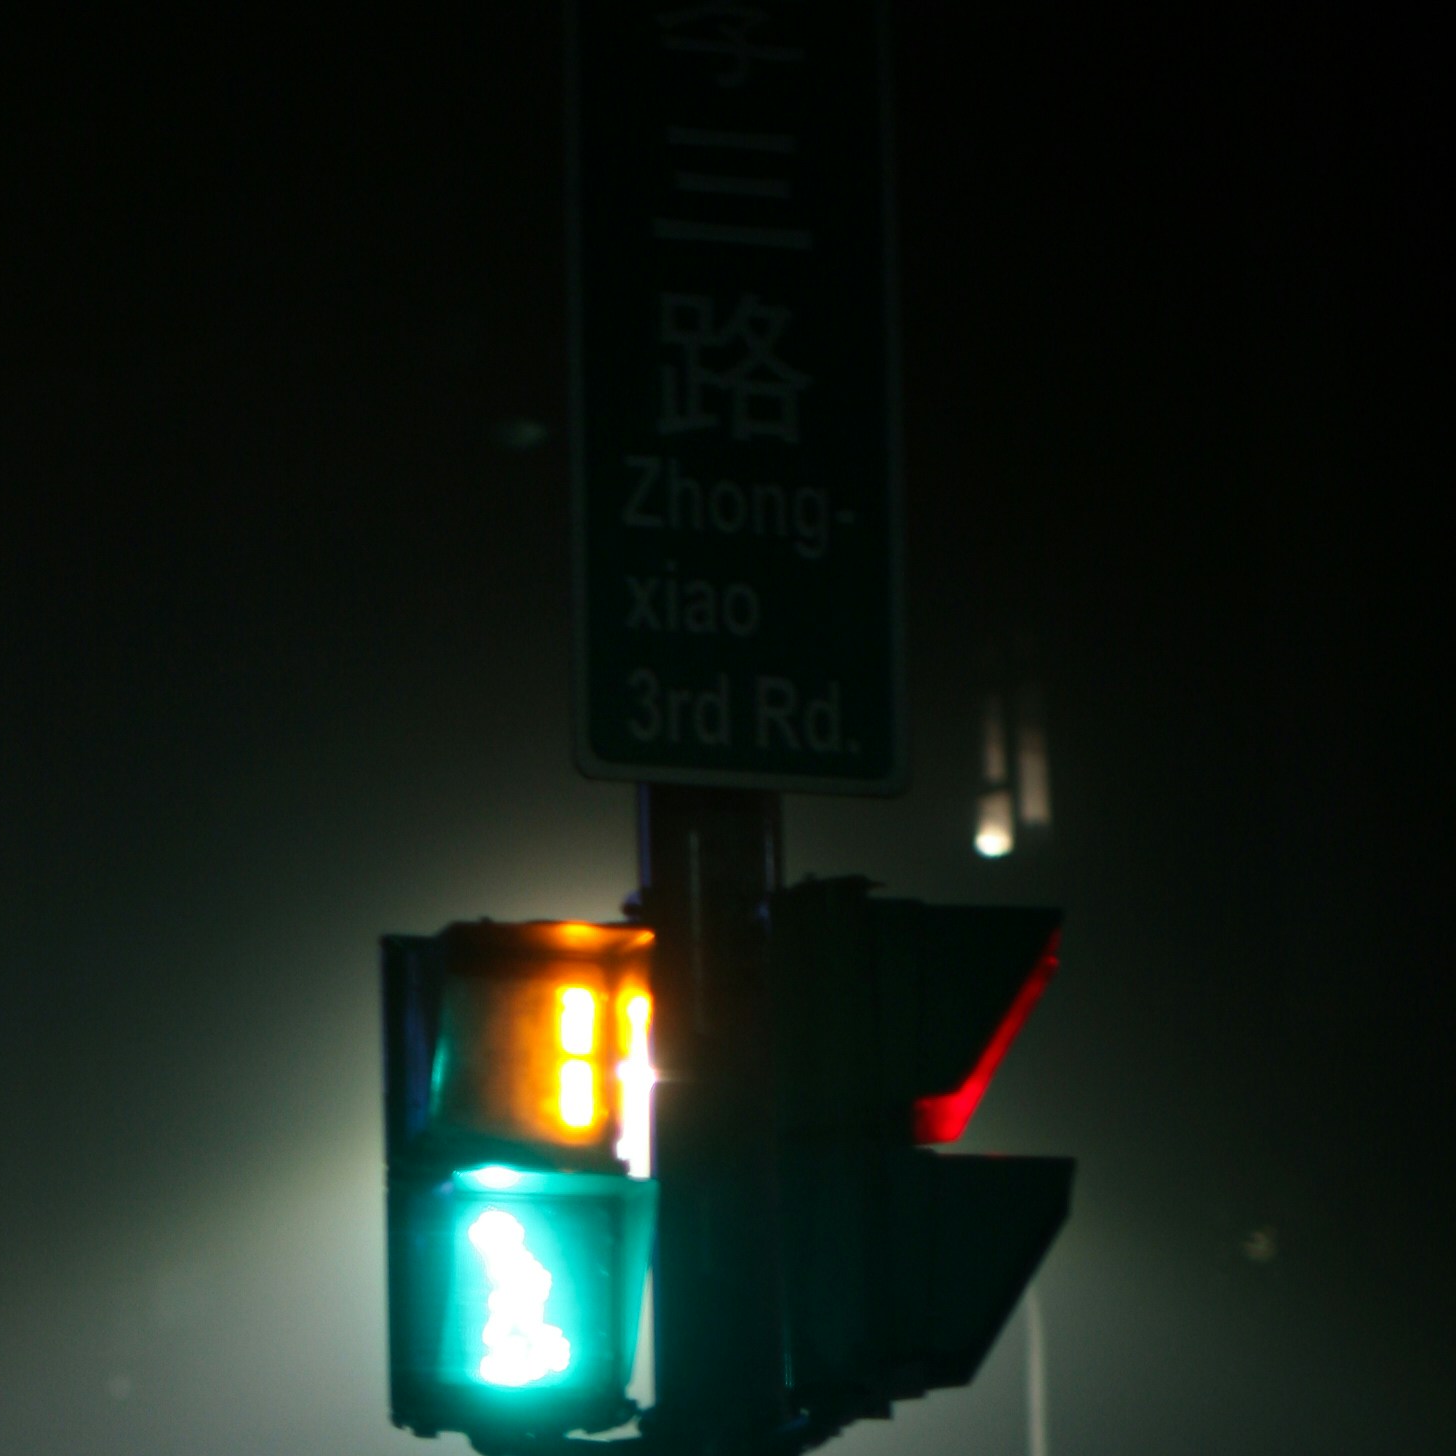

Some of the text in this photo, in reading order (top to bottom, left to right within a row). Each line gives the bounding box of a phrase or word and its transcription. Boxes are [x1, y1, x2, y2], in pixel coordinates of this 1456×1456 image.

[621, 453, 858, 560] Zhong-
[624, 559, 761, 638] xiao
[627, 667, 863, 754] 3rd Rd.
